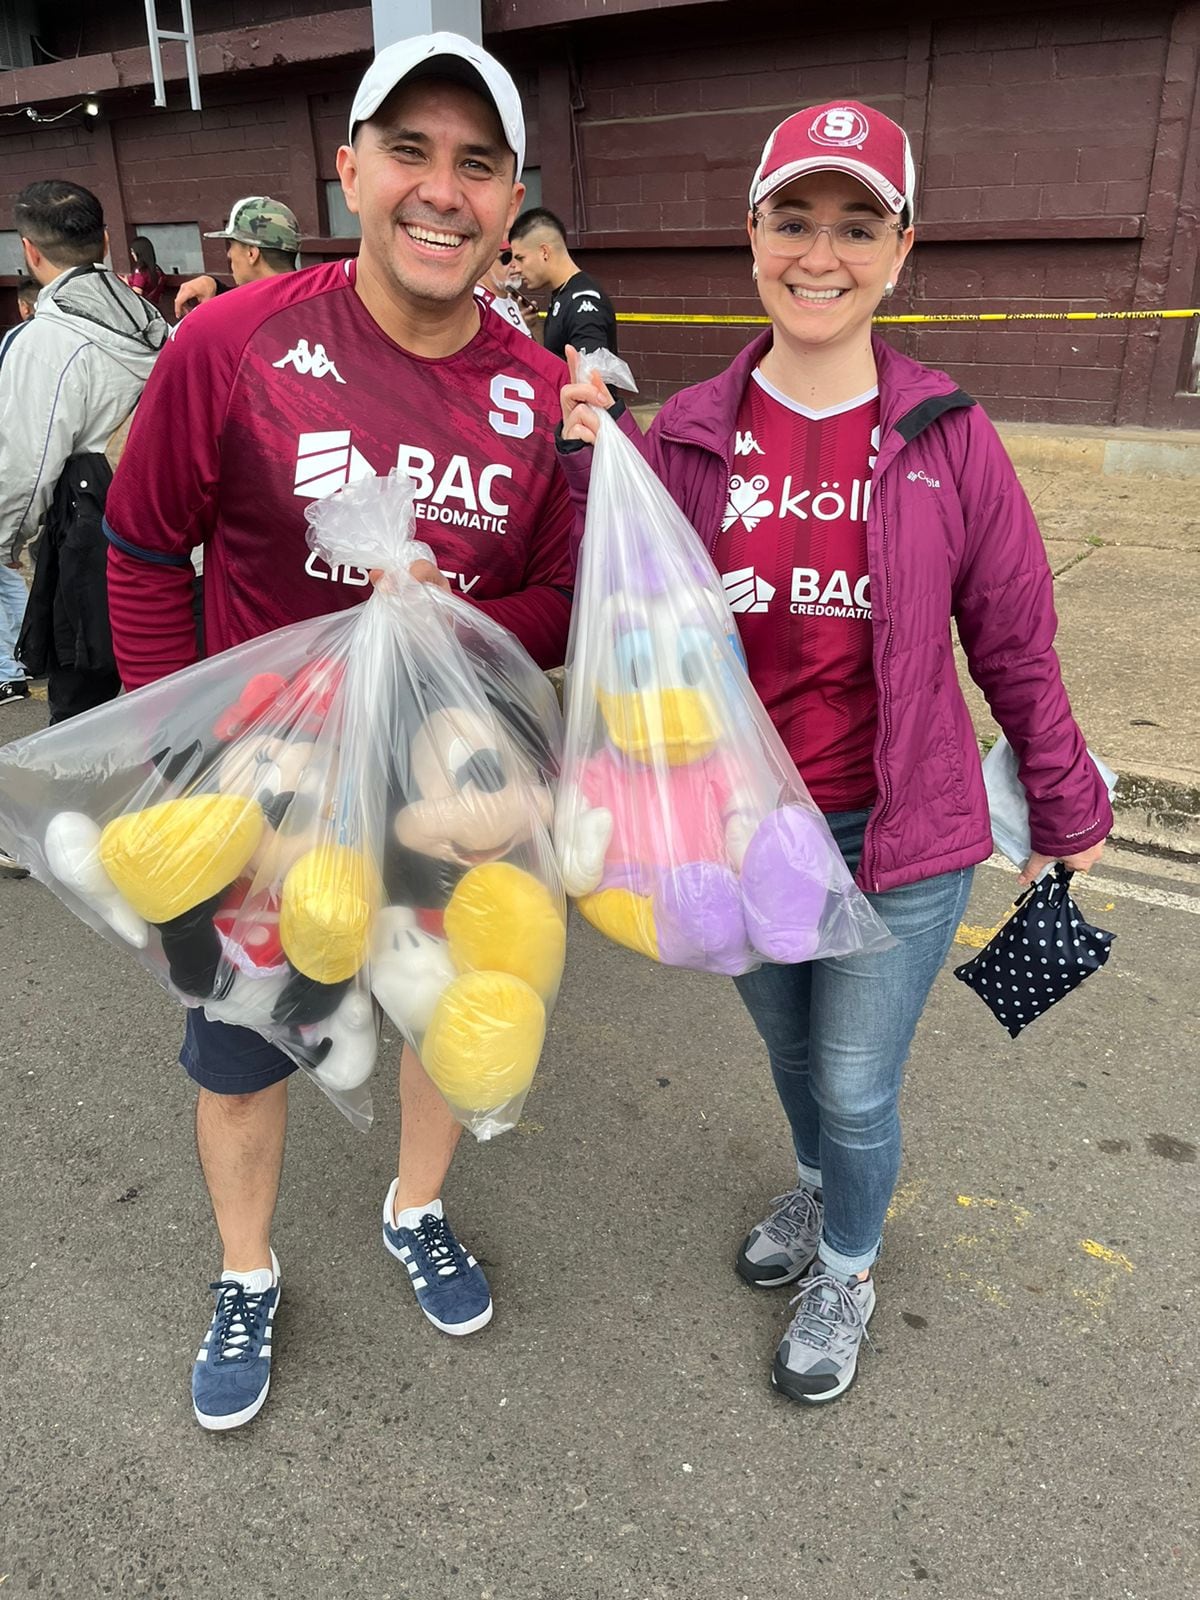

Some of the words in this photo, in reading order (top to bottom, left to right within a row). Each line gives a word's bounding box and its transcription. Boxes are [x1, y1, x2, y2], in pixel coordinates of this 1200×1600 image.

[823, 110, 855, 138] S
[507, 306, 521, 326] S
[488, 373, 535, 440] S
[396, 443, 513, 516] BAC
[414, 502, 508, 535] EDOMATIC
[790, 567, 872, 609] BAC
